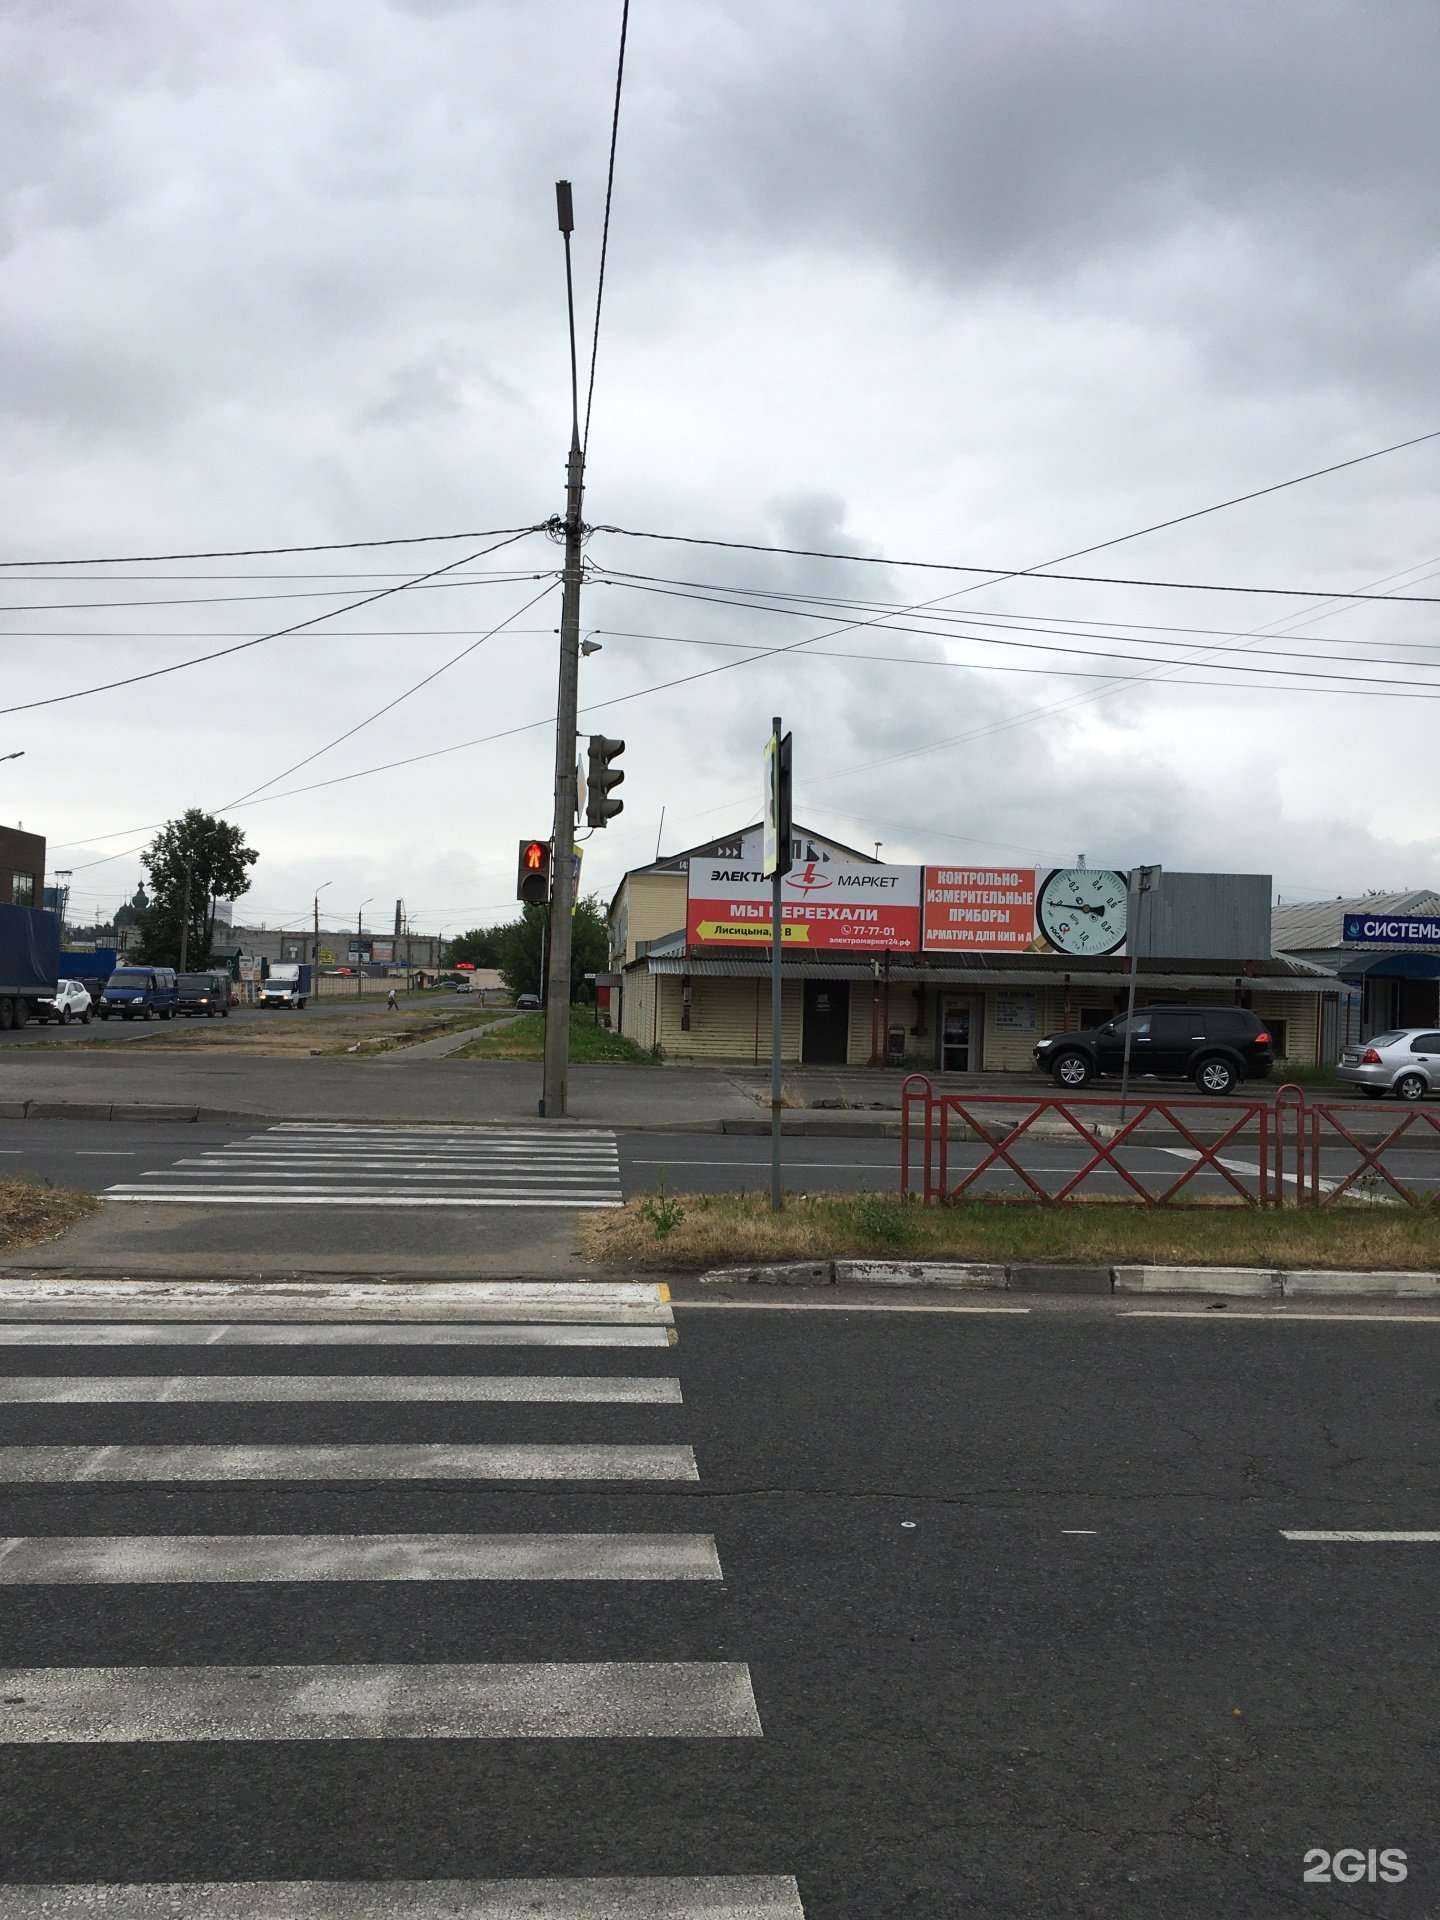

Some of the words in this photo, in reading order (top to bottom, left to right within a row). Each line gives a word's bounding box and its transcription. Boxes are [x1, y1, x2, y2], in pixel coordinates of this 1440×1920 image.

[711, 869, 778, 883] ЭЛЕКТР
[837, 875, 899, 888] МАРКЕТ
[937, 871, 1024, 886] КОНТРОЛЬНО-
[927, 889, 1033, 905] ИЗМЕРИТЕЛЬНЫЕ
[730, 904, 763, 917] МЫ
[949, 908, 1010, 923] ПРИБОРЫ
[714, 926, 772, 938] Лисицына,
[853, 926, 895, 936] 77-77-01
[926, 929, 974, 941] АРМАТУРА
[976, 930, 996, 943] ДЛЯ
